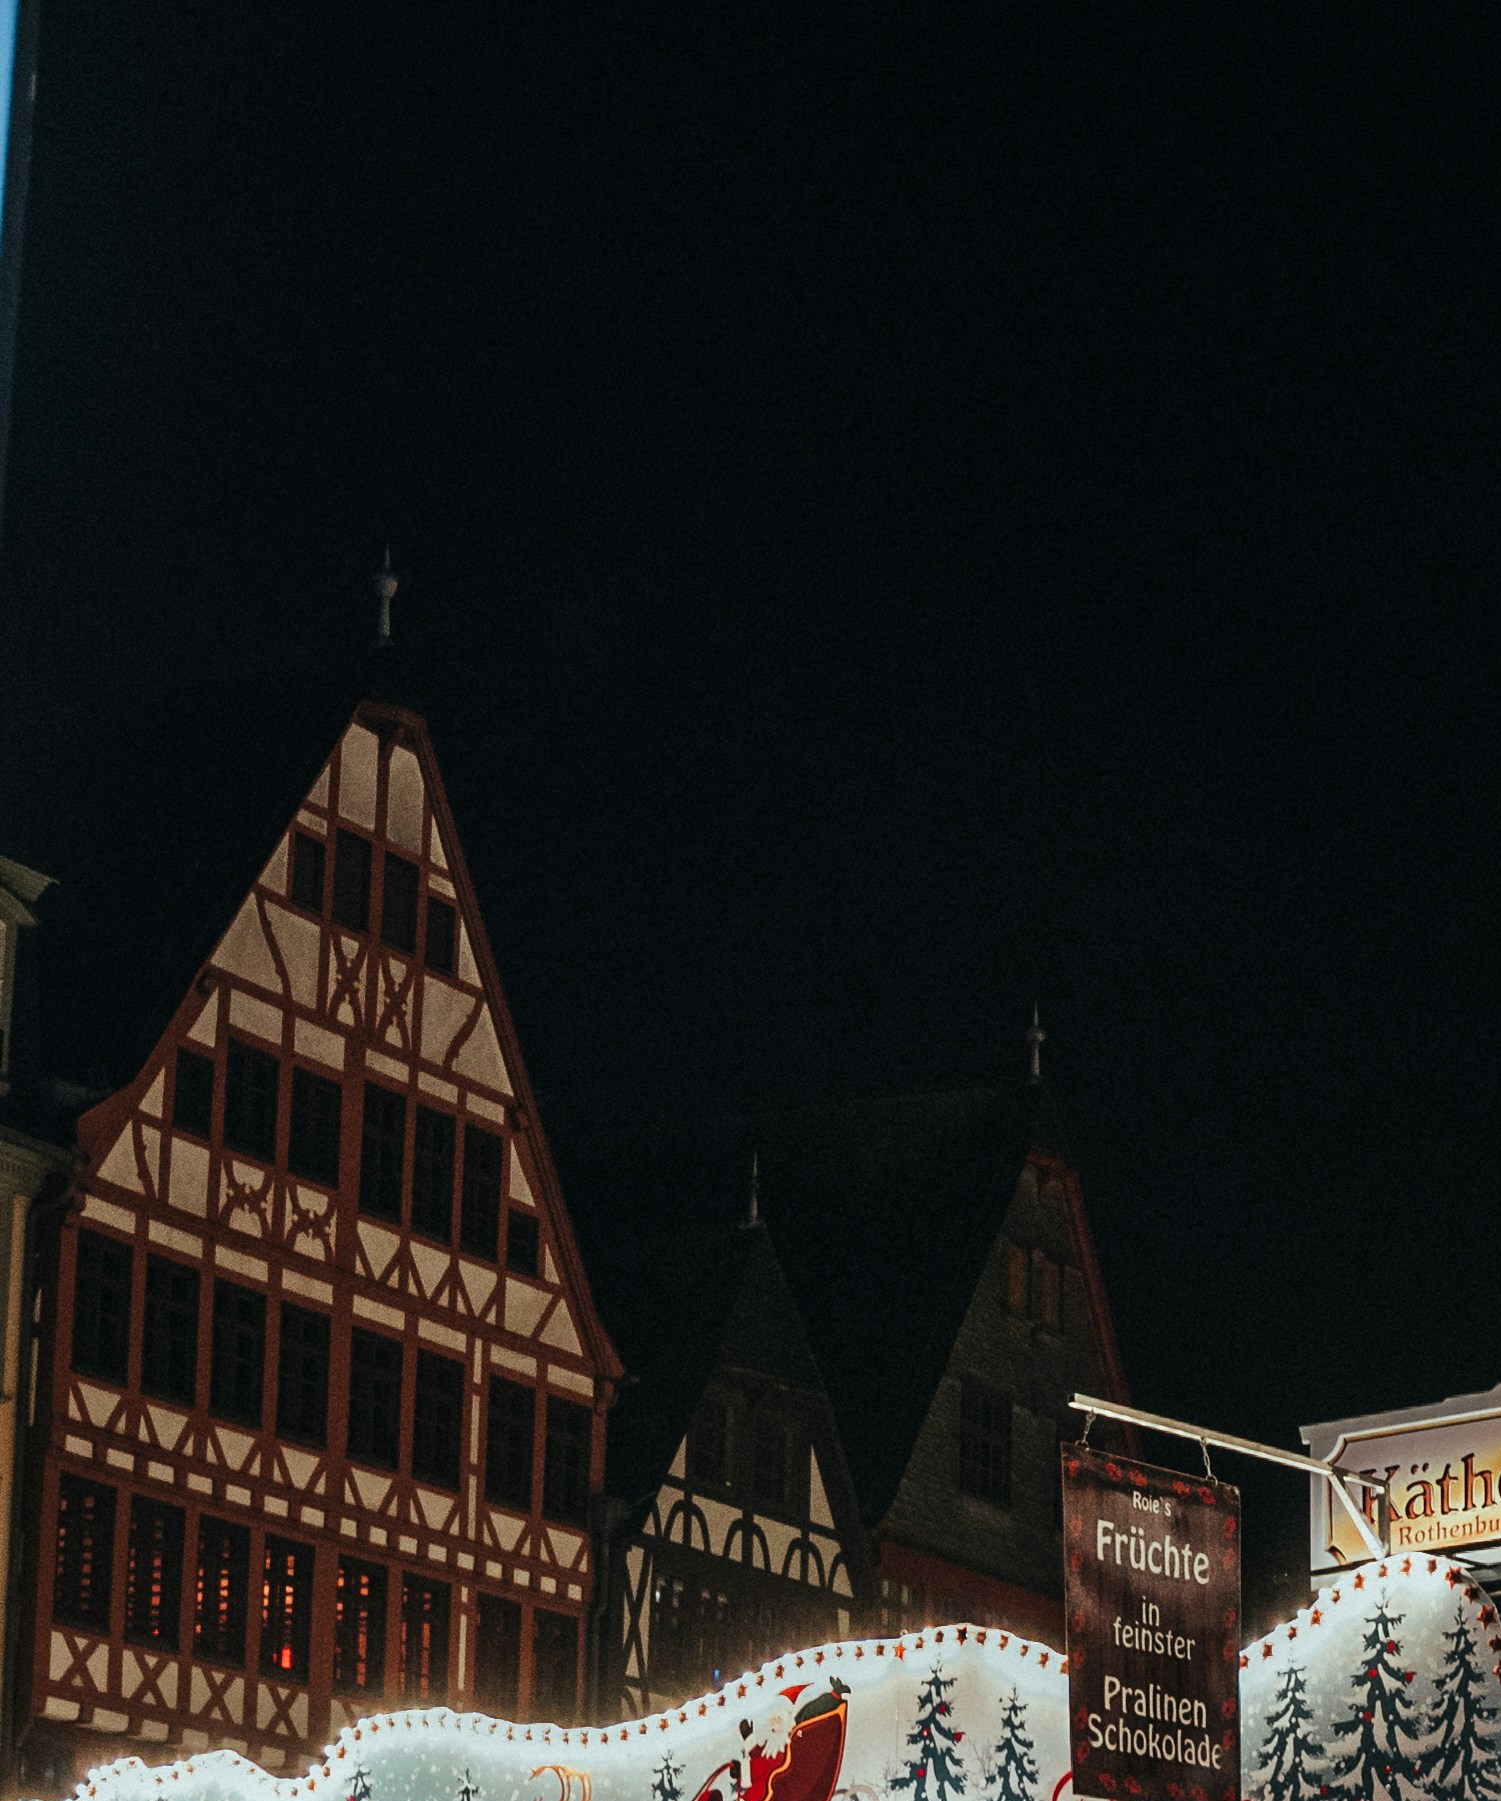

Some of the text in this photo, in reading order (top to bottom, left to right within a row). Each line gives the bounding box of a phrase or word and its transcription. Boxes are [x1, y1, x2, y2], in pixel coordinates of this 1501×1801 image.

[1096, 1518, 1211, 1585] Früchte
[1112, 1615, 1197, 1661] feinster
[1141, 1595, 1161, 1628] in
[1103, 1674, 1208, 1729] Pralinen
[1087, 1712, 1223, 1771] Schokolade
